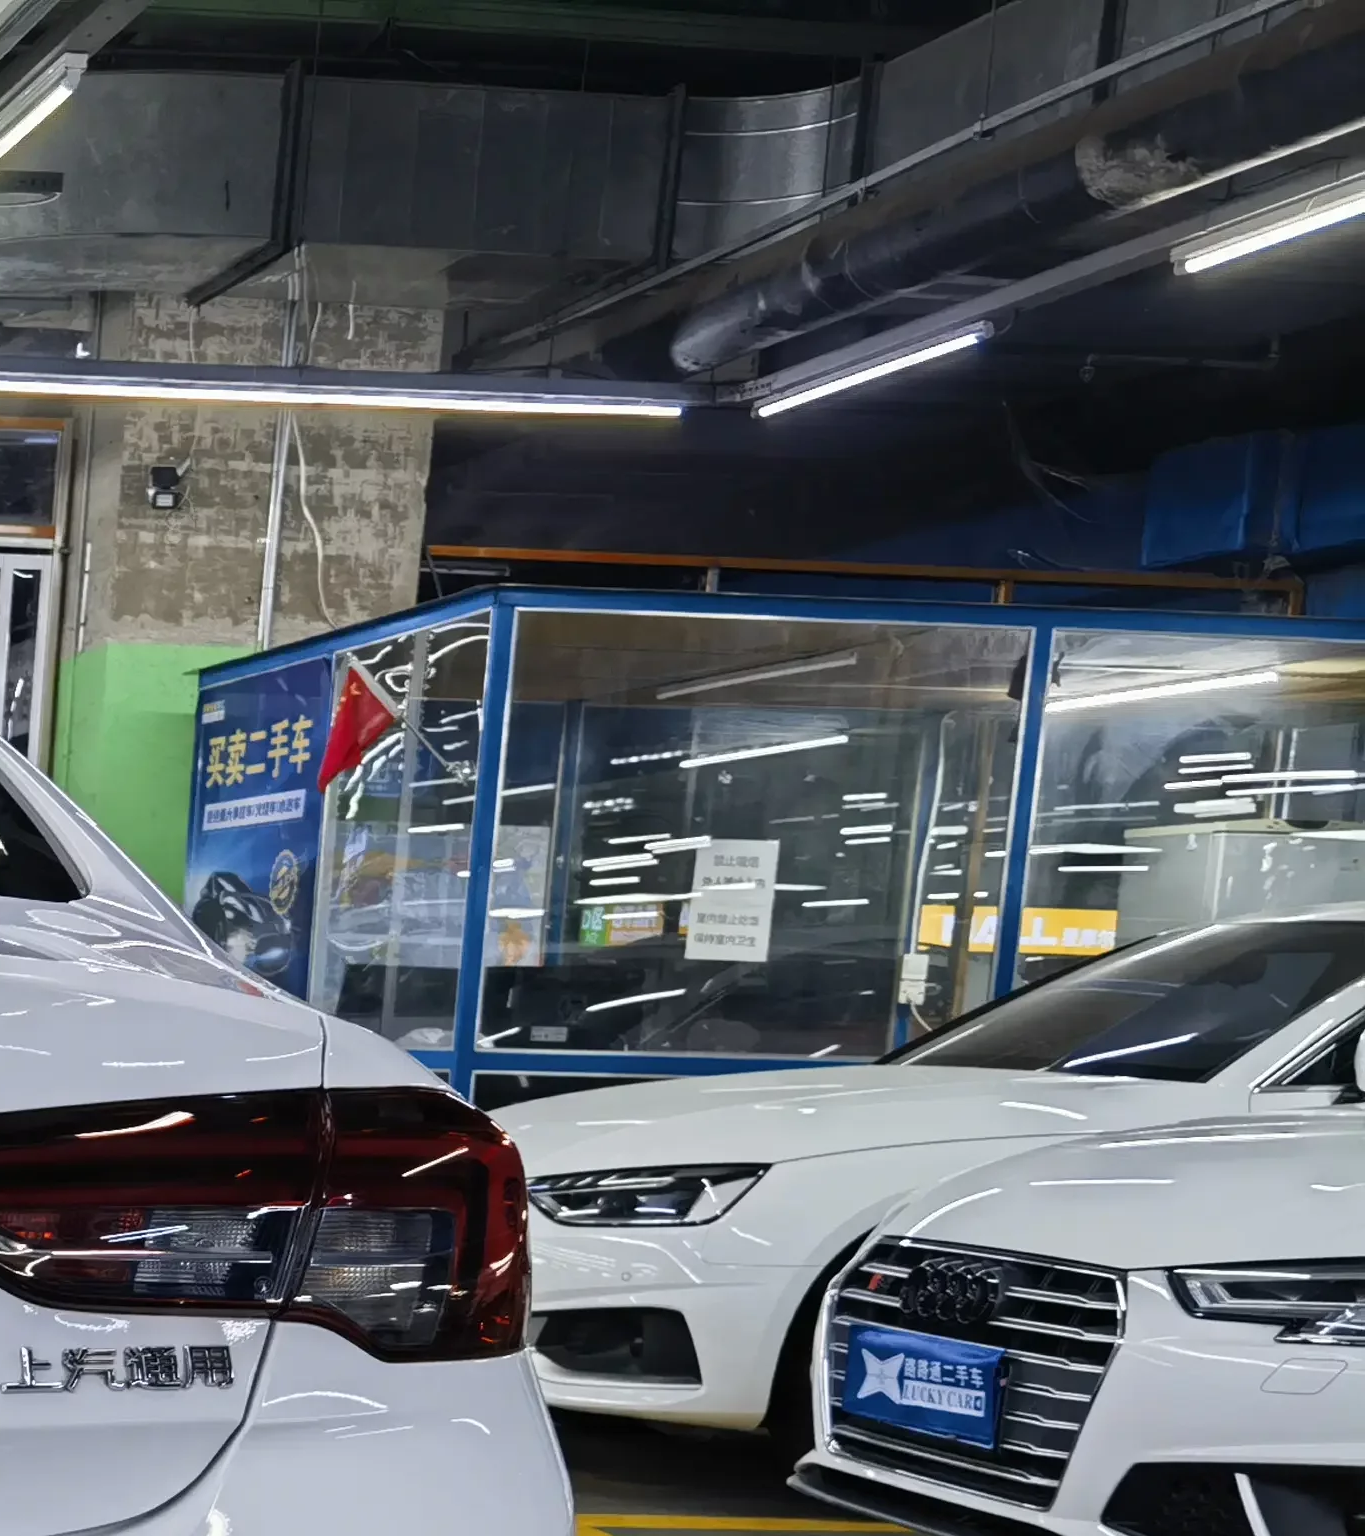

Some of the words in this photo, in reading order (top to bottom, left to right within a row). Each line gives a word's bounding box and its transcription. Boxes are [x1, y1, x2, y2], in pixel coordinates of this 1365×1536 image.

[206, 713, 314, 788] 买卖二手车
[0, 1345, 235, 1393] 上汽通用
[903, 1357, 985, 1389] 路路通二手车
[902, 1383, 945, 1408] LUCKY
[947, 1390, 975, 1411] CAR
